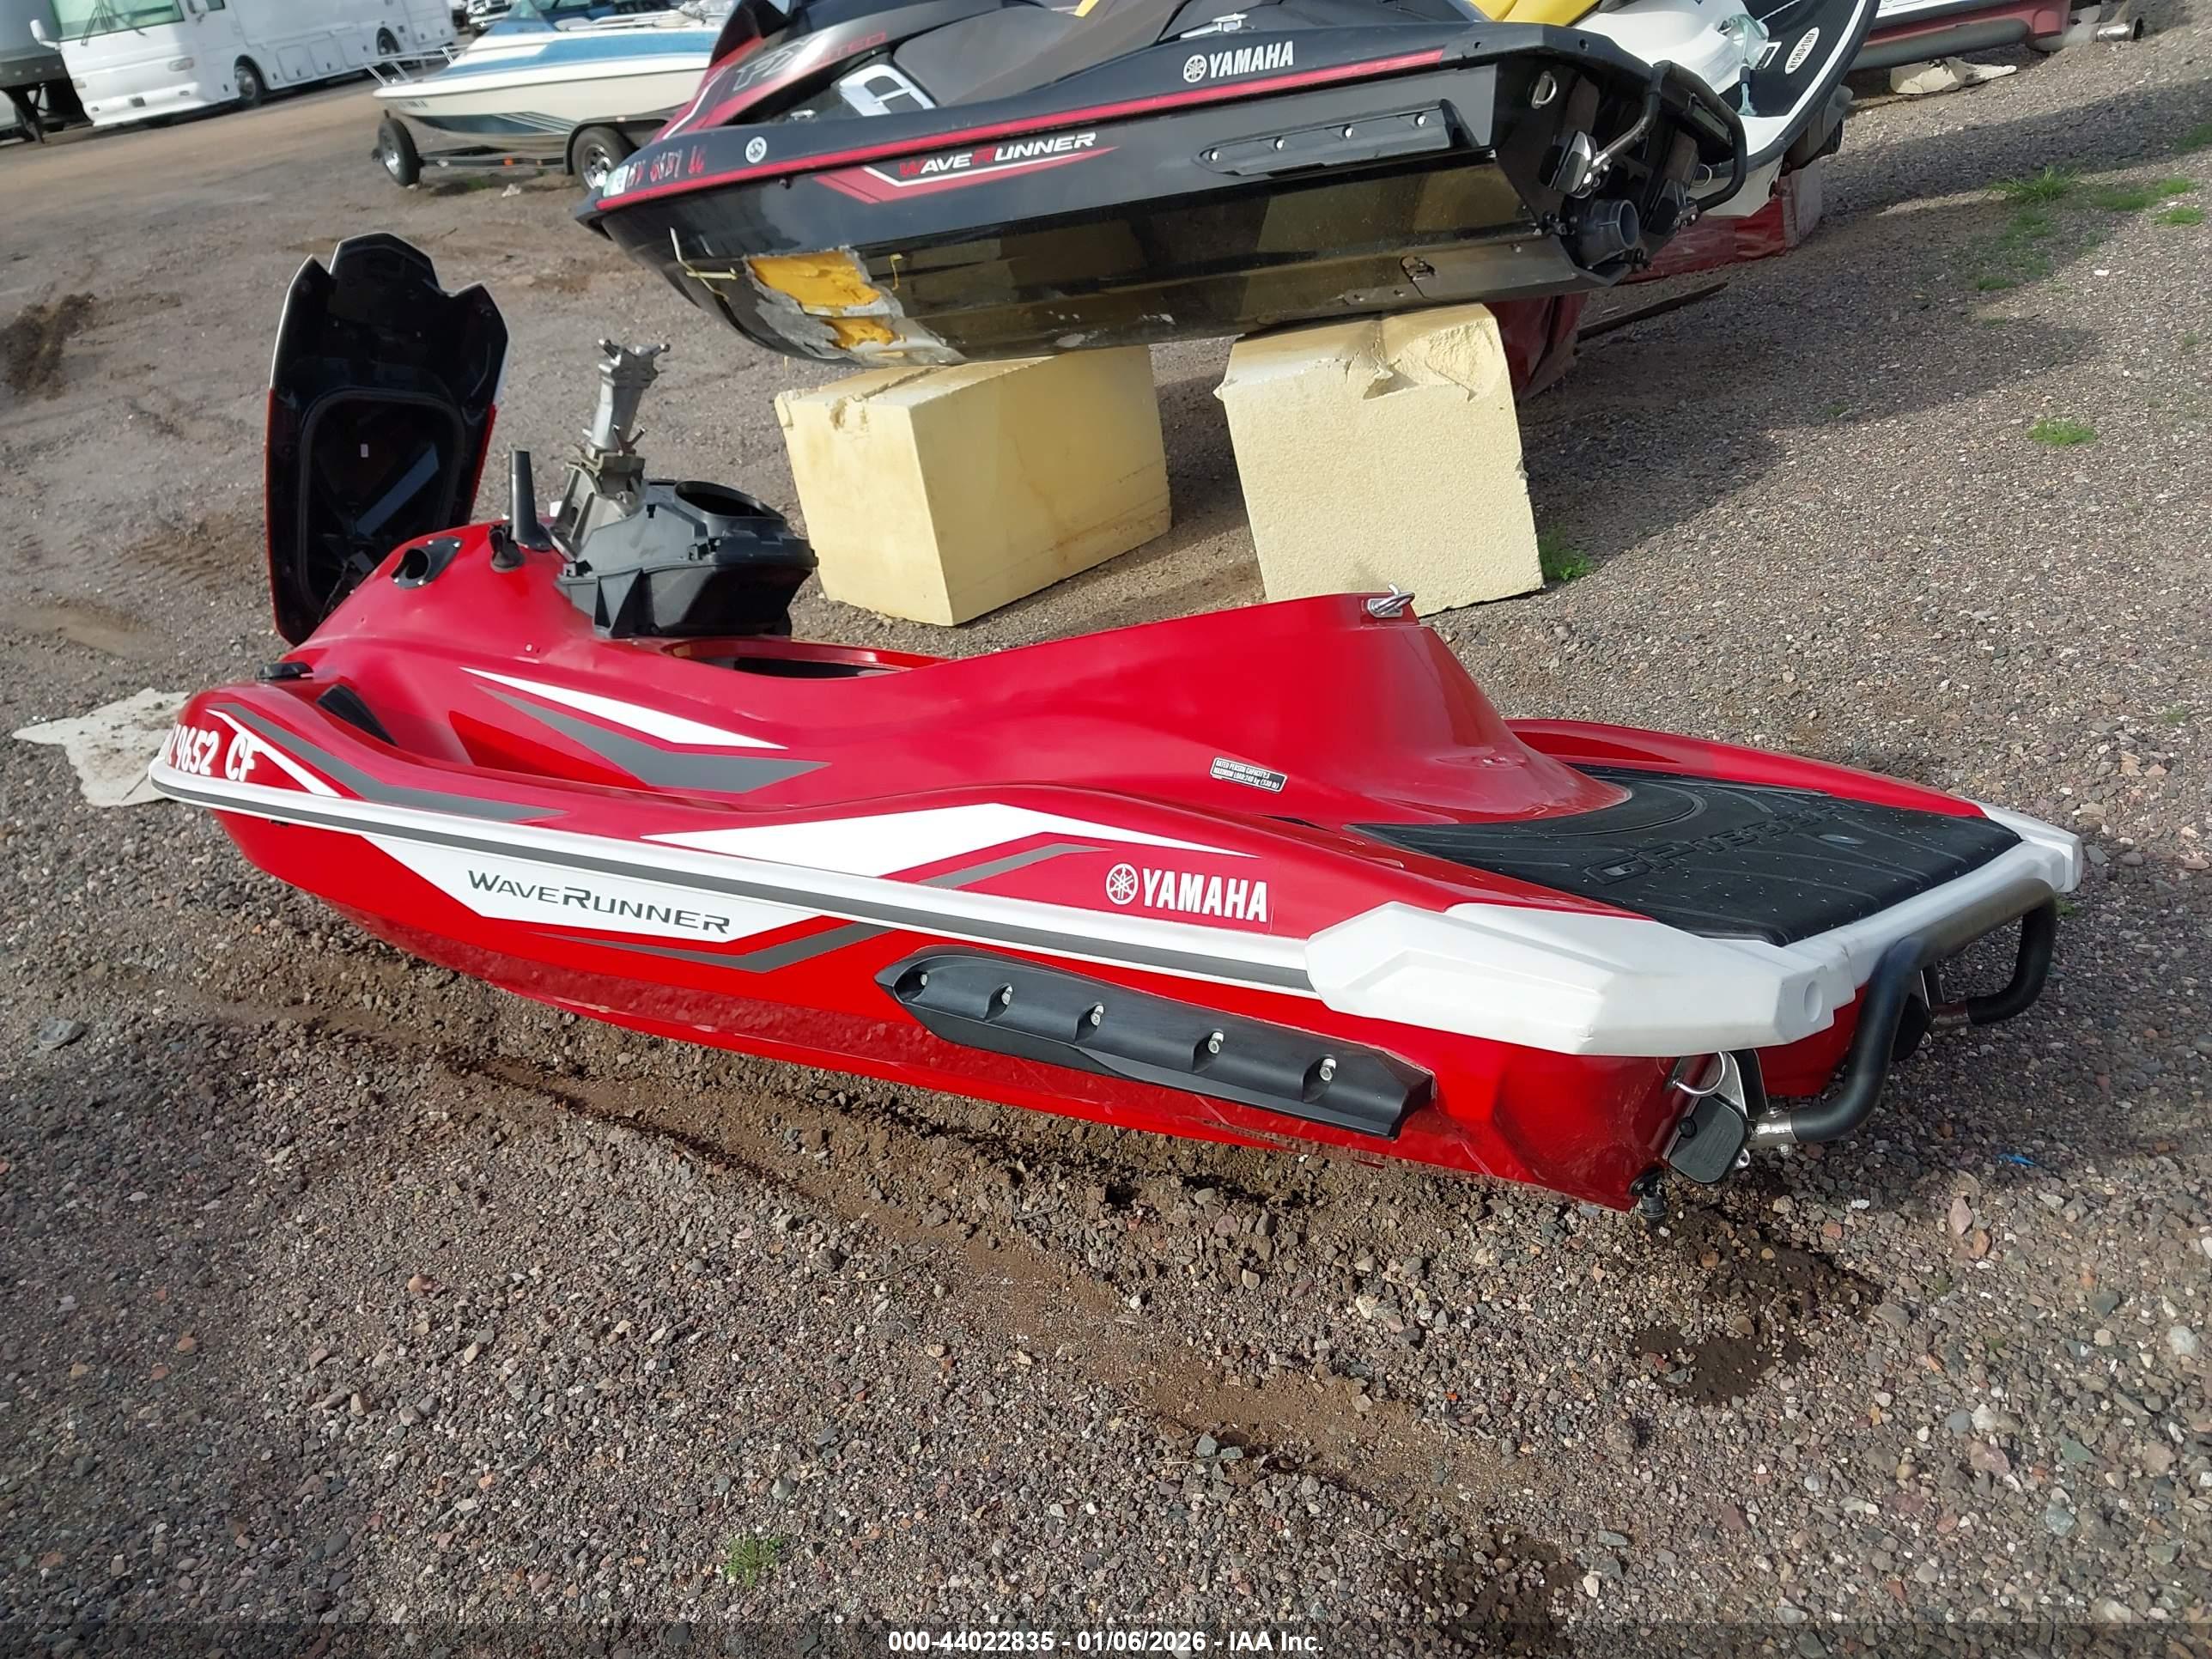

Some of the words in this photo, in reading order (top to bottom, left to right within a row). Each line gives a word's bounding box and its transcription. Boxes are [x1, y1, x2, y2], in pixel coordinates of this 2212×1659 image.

[1209, 40, 1294, 78] YAMAHA
[899, 131, 1097, 176] WAVERUNNER
[225, 732, 259, 782] CF
[468, 870, 730, 934] WAVERUNNER
[1142, 867, 1267, 923] YAMAHA
